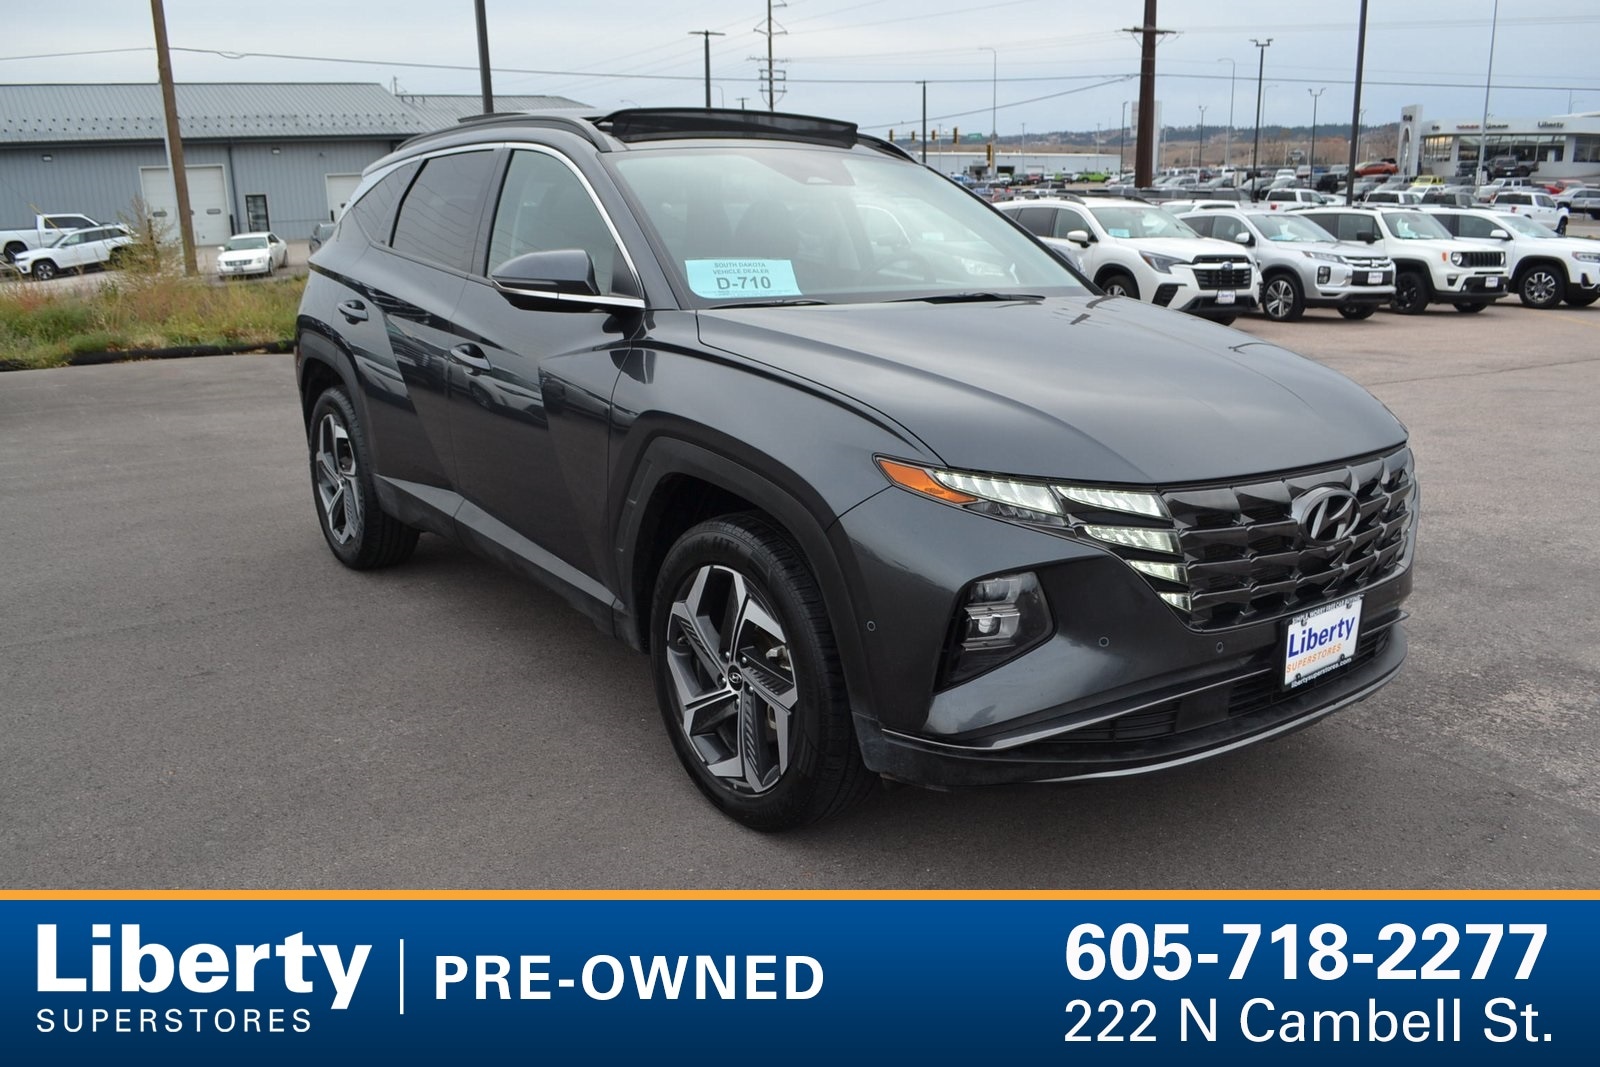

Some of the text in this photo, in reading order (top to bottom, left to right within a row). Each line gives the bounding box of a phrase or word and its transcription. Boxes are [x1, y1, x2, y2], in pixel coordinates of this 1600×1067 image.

[716, 276, 771, 290] D-710
[1288, 617, 1355, 658] Liberty
[1286, 643, 1342, 673] SUPERSTORES
